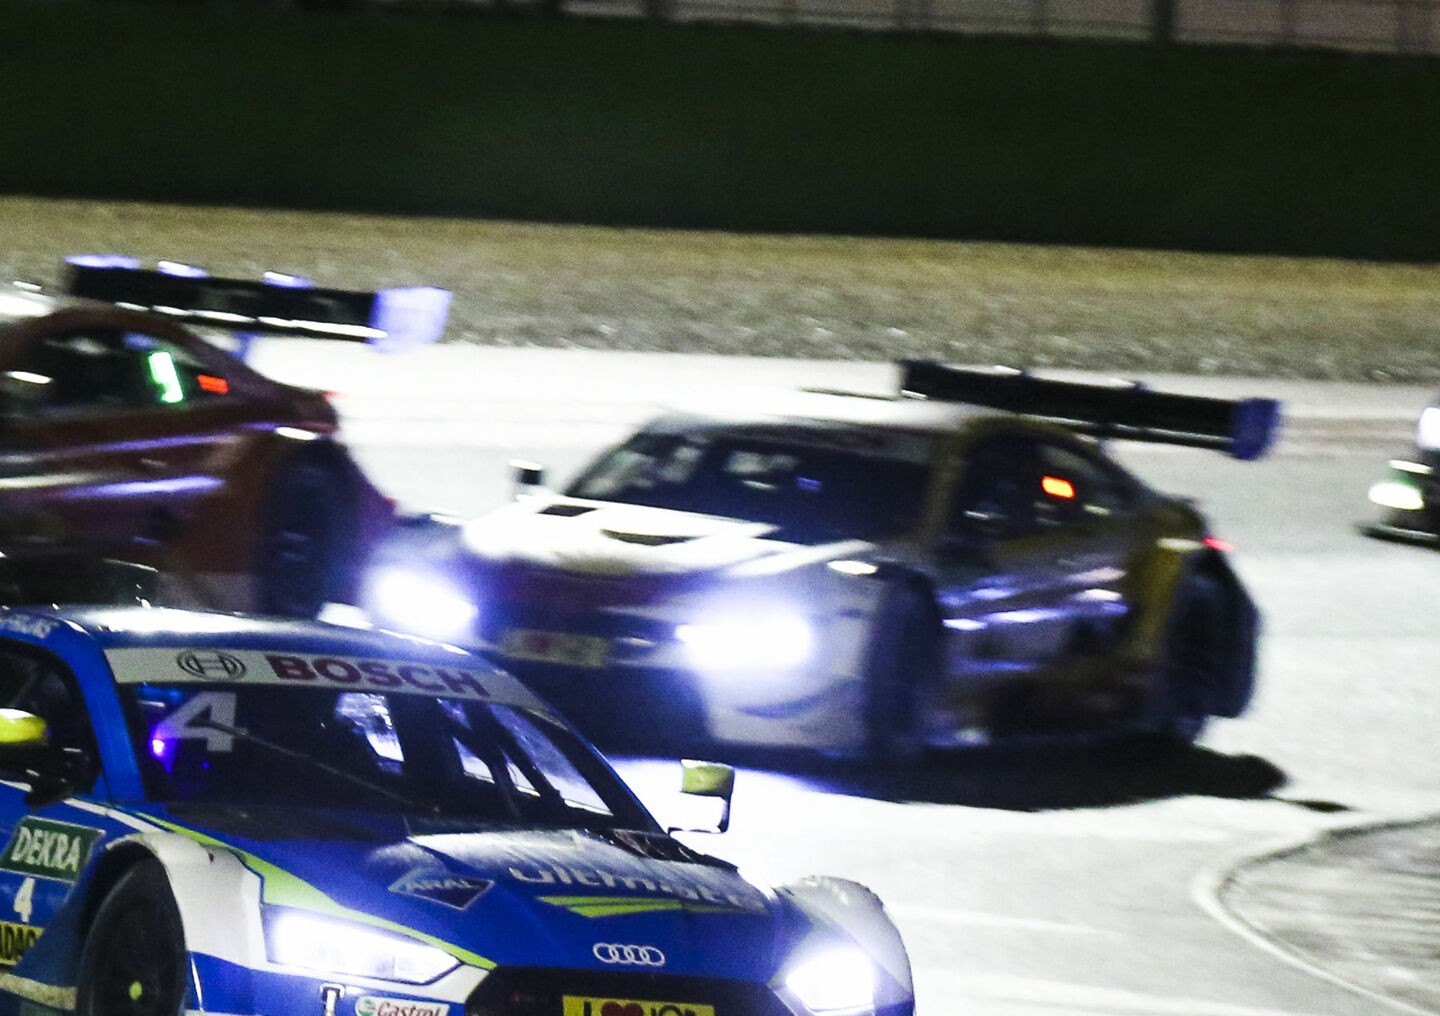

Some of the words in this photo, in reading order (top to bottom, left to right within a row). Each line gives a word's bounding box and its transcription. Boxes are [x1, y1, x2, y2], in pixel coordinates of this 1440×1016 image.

[266, 655, 490, 697] BOSCH
[152, 691, 236, 752] 4
[11, 826, 81, 871] DEKRA
[13, 877, 35, 923] 4
